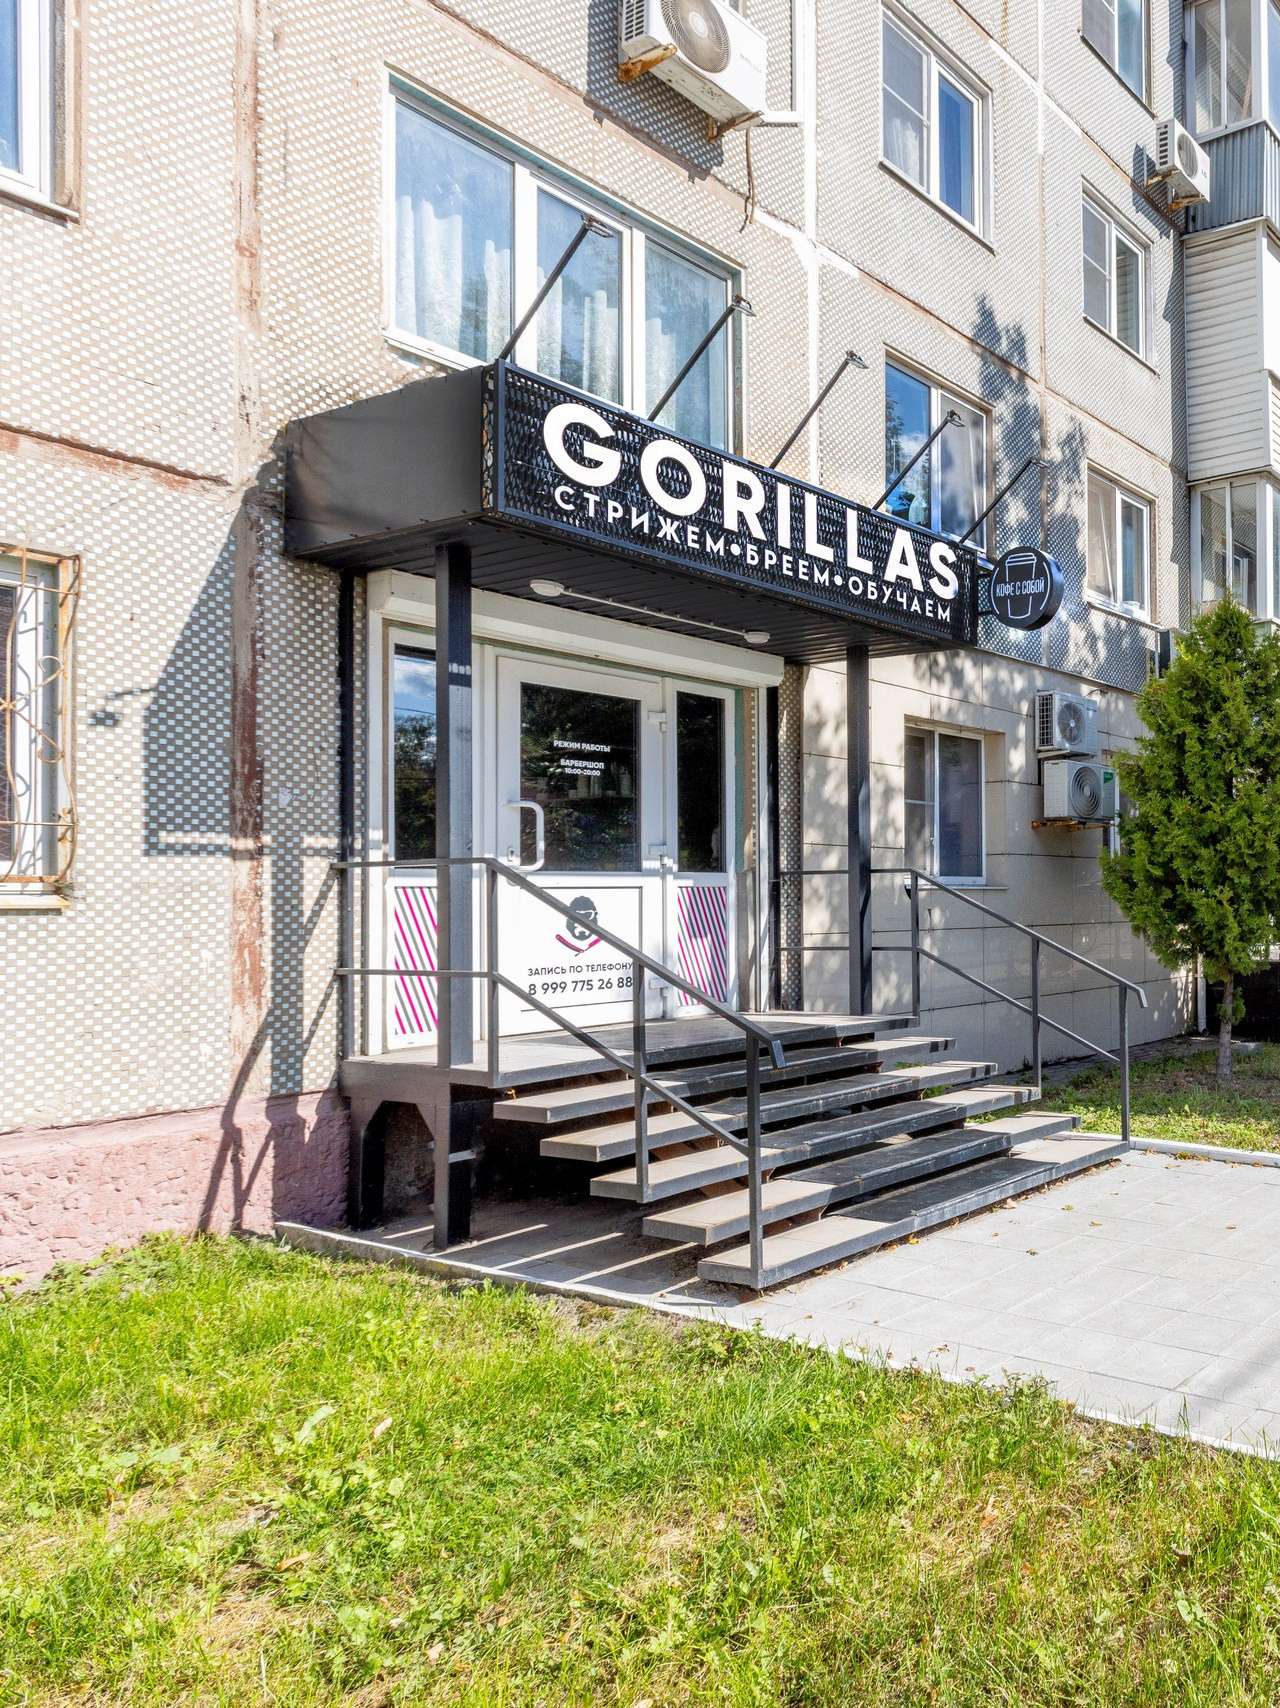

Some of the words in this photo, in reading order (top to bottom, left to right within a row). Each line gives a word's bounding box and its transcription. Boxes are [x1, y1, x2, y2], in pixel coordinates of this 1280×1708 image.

[543, 402, 959, 600] GORILLAS
[554, 485, 725, 556] СТРИЖЕМ
[746, 543, 829, 587] БРЕЕМ
[848, 576, 951, 622] ОБУЧАЕМ
[996, 582, 1015, 597] КОФЕ
[1015, 581, 1021, 595] С
[1021, 576, 1045, 595] СОБОЙ
[553, 740, 580, 750] РЕЖИМ
[581, 743, 611, 753] РАБОТЫ
[560, 758, 605, 769] БАРБЕРШОП
[528, 966, 566, 977] ЗАПИСЬ
[569, 965, 583, 974] ПО
[585, 962, 633, 973] ТЕЛЕФОНУ
[528, 984, 537, 996] 8
[541, 981, 567, 995] 999
[571, 979, 594, 992] 775
[597, 978, 613, 991] 26
[617, 976, 633, 989] 88
